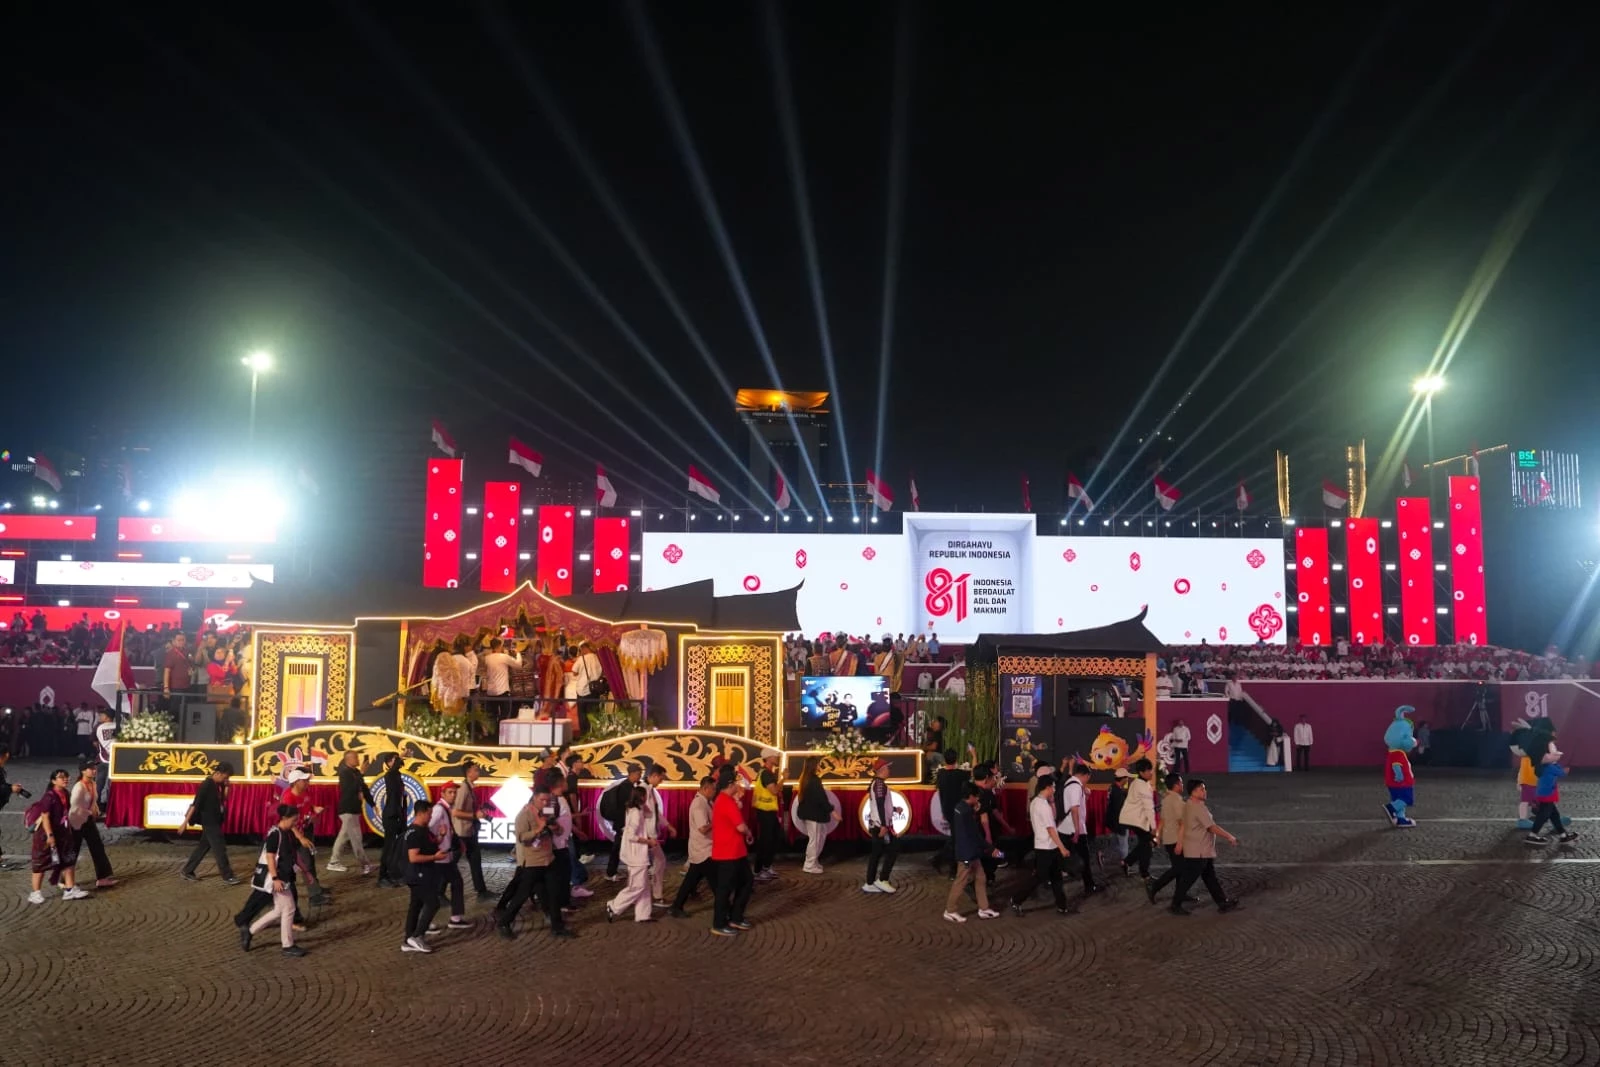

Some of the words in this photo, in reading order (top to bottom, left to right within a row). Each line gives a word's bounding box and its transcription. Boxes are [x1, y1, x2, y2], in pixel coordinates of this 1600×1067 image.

[947, 540, 993, 549] DIRGAHAYU
[929, 550, 967, 558] REPUBLIK
[968, 550, 1011, 559] INDONESIA
[925, 567, 972, 623] 81
[1011, 676, 1037, 685] VOTE
[1525, 691, 1549, 718] 81
[478, 822, 516, 840] EKR
